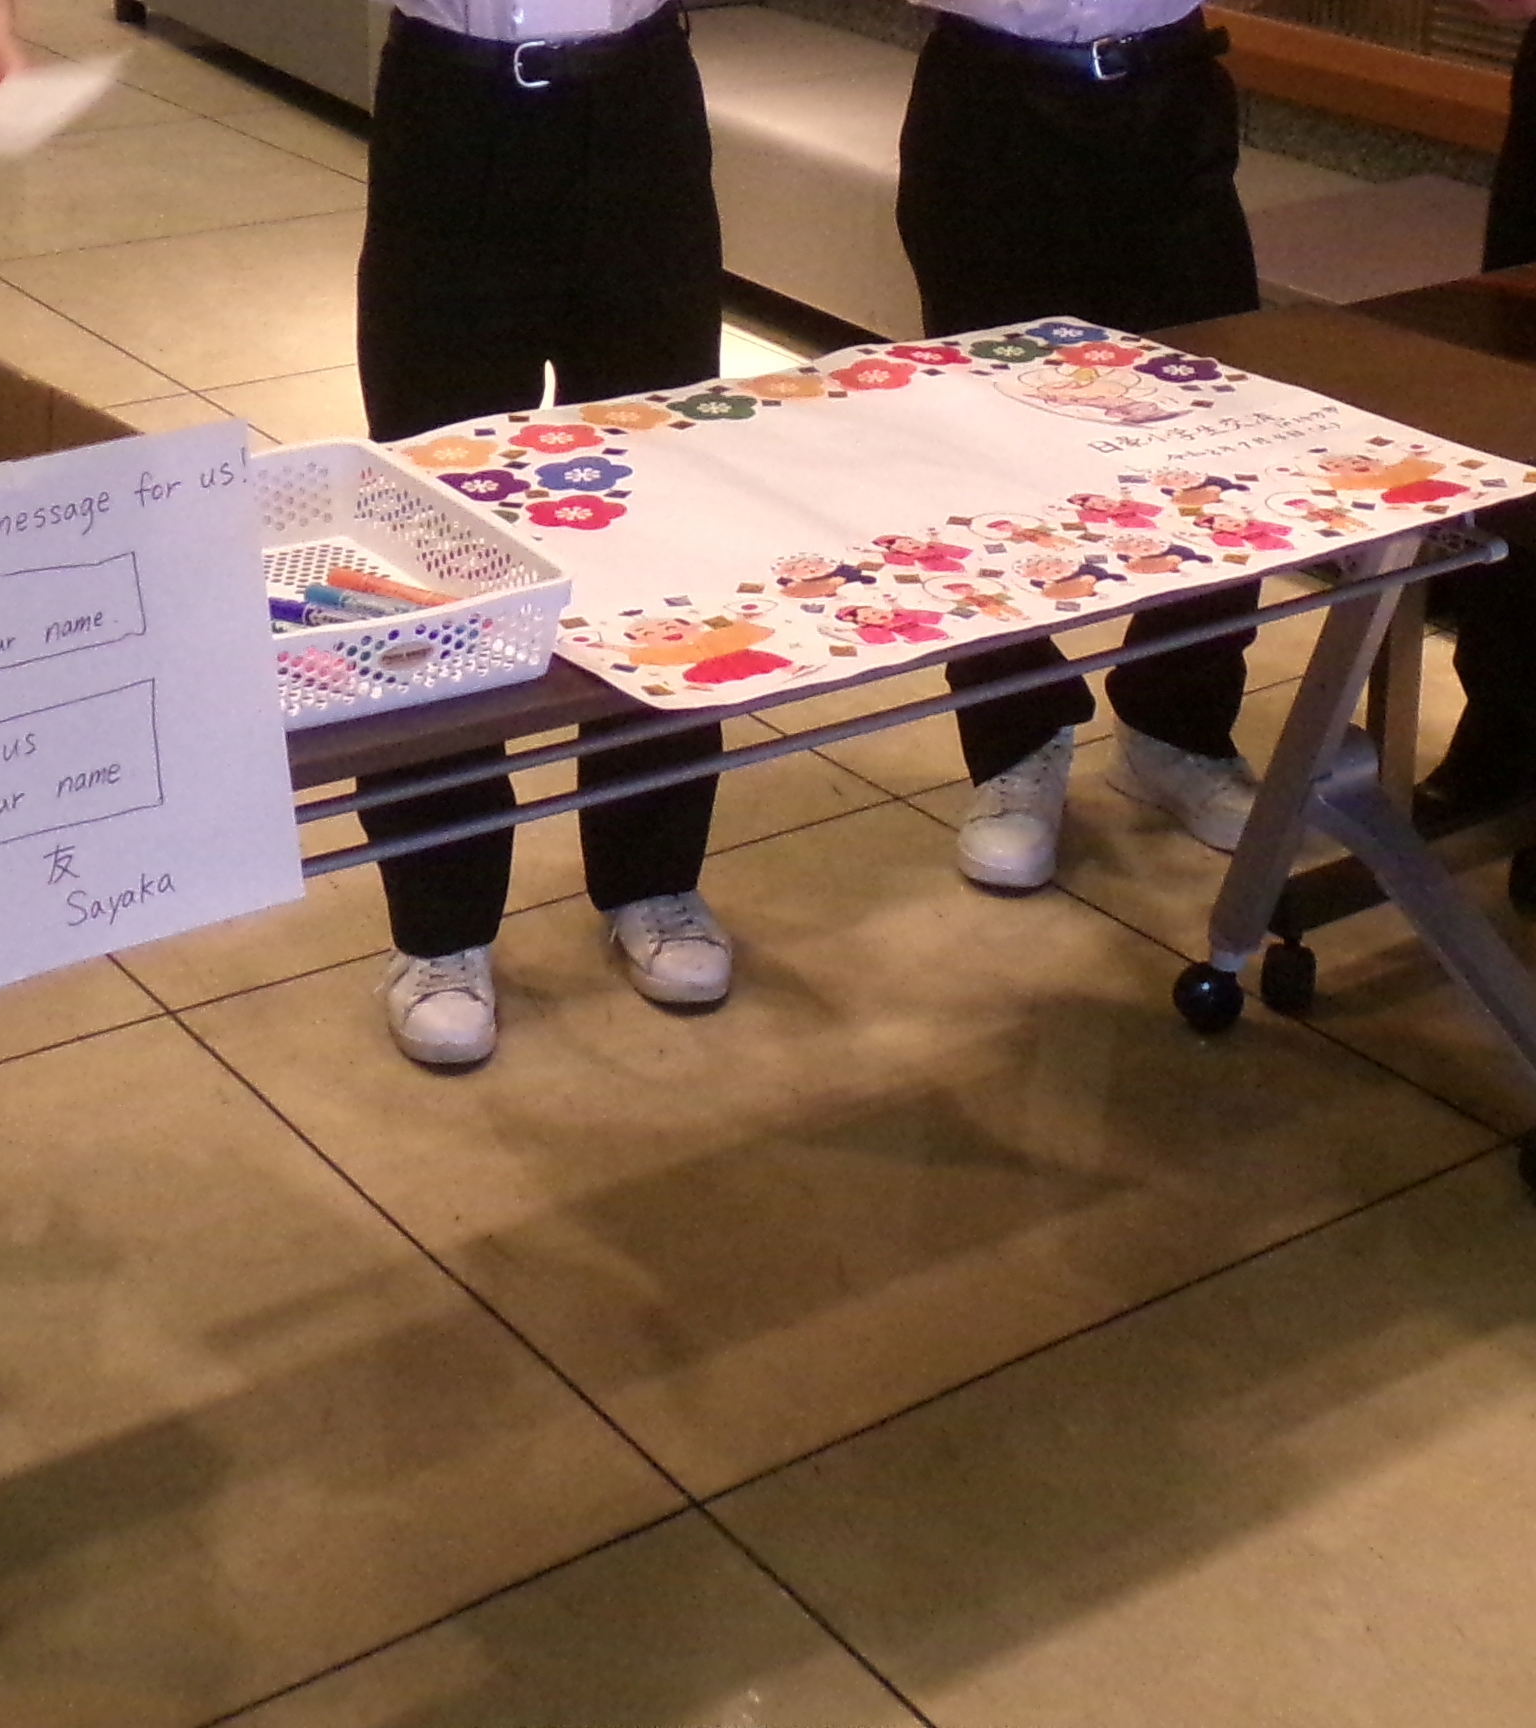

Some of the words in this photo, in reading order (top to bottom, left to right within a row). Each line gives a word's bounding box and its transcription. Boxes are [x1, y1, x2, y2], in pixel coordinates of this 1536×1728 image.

[133, 471, 182, 508] for
[199, 446, 247, 489] us!
[2, 732, 37, 762] us
[55, 762, 122, 799] name
[43, 844, 81, 886] 友
[66, 872, 176, 927] Sayaka
